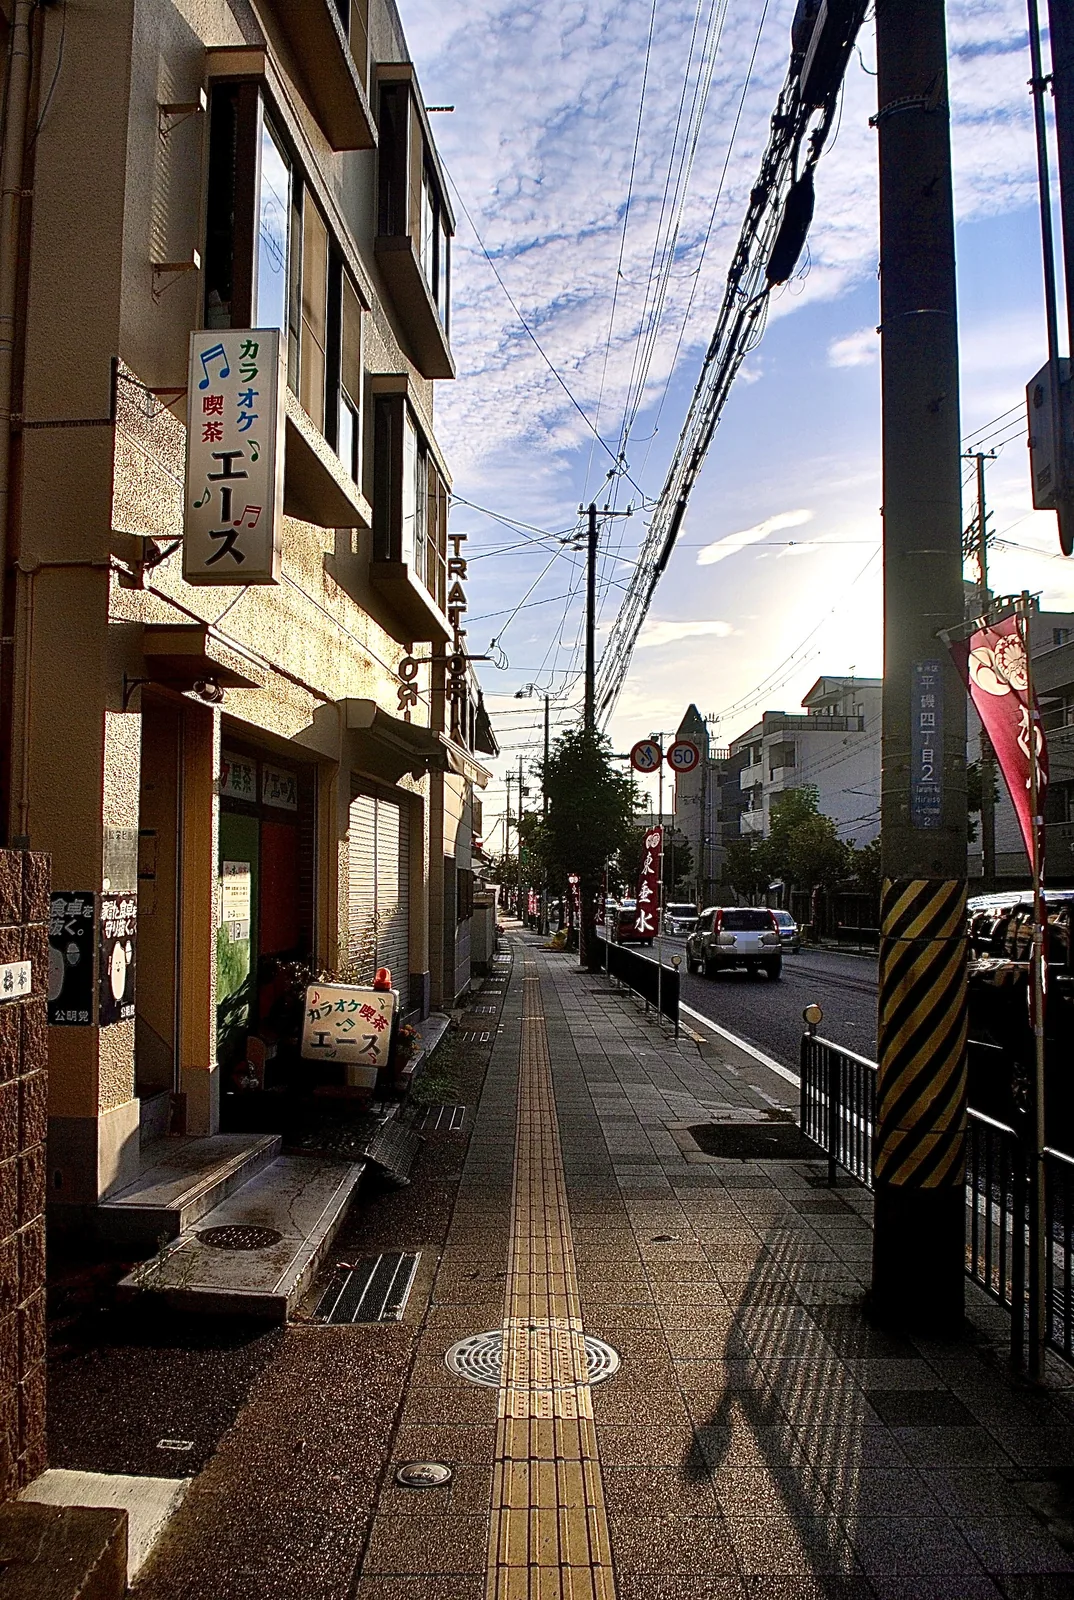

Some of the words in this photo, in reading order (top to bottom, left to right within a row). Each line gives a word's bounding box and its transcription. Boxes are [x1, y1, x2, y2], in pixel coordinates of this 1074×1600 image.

[236, 339, 259, 433] カラオケ
[201, 394, 224, 443] 喫茶
[204, 449, 249, 567] エース
[674, 750, 693, 763] 50
[634, 851, 655, 933] 東垂水
[55, 1010, 89, 1022] 公明党
[307, 998, 389, 1032] カラオケ喫茶
[310, 1030, 381, 1055] エース
